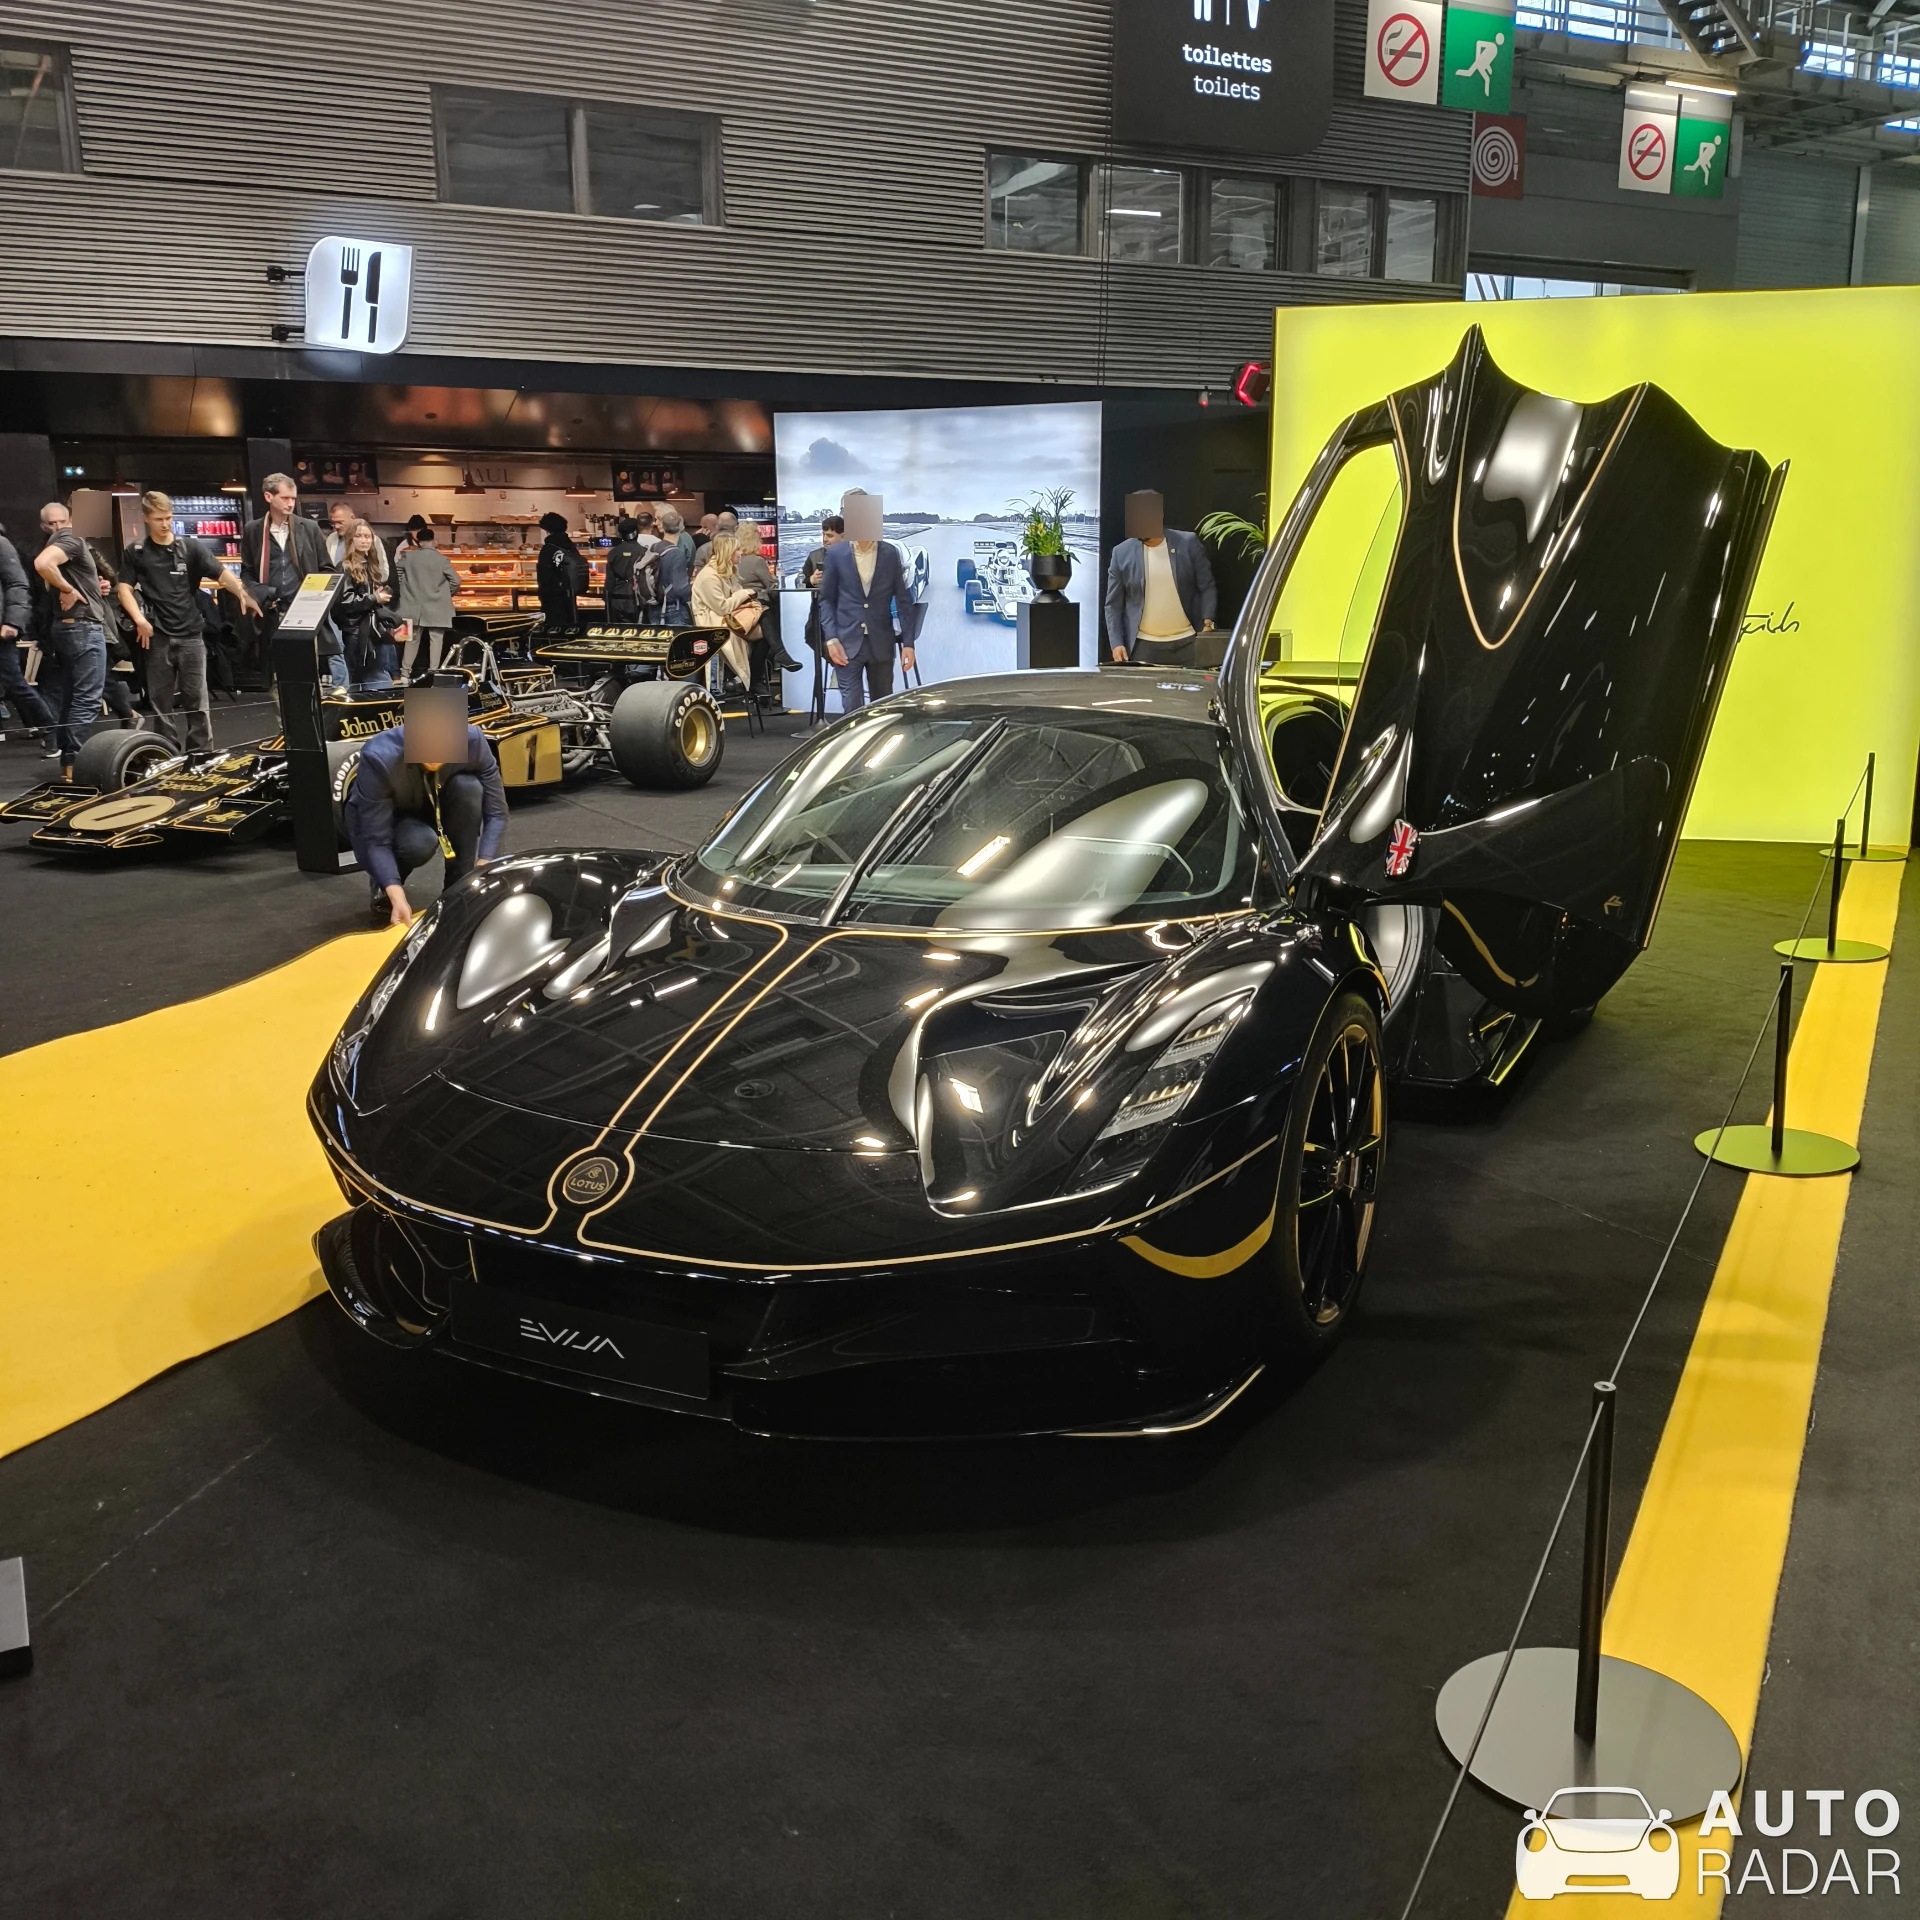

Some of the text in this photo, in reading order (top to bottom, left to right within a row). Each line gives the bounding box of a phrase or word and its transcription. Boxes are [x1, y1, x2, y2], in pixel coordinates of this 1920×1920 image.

[1182, 44, 1272, 73] toilettes
[1193, 75, 1261, 100] toilets
[340, 711, 404, 737] John Pla
[526, 734, 537, 780] 1
[570, 1178, 606, 1191] LOTUS
[520, 1318, 625, 1359] EVIJA
